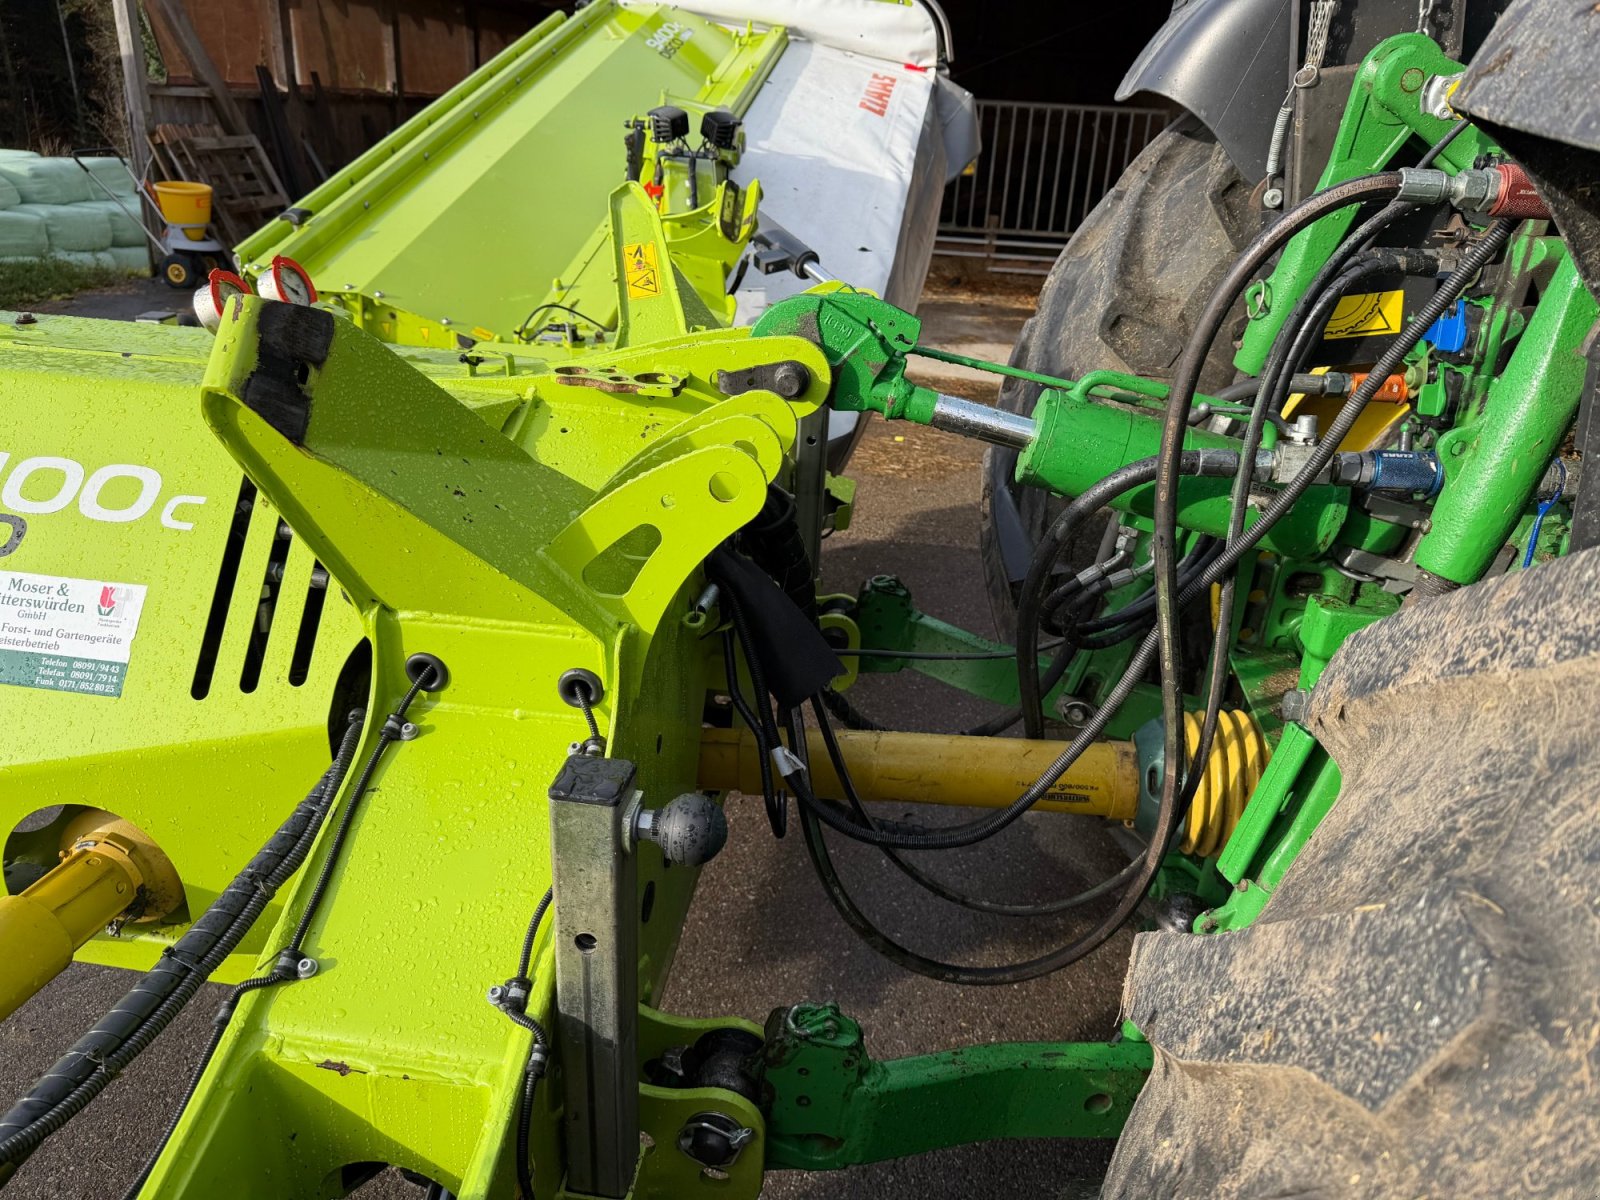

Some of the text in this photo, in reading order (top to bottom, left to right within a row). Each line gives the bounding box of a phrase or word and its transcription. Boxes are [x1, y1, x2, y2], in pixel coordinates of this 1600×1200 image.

[859, 72, 897, 117] CLAAS
[8, 577, 70, 597] Moser &
[0, 592, 85, 613] tterswürden
[17, 609, 47, 620] GmbH
[1, 622, 122, 645] Forst- und Gartengeräte
[41, 657, 68, 668] Telefon
[38, 666, 66, 678] Telefax
[35, 676, 55, 687] Funk
